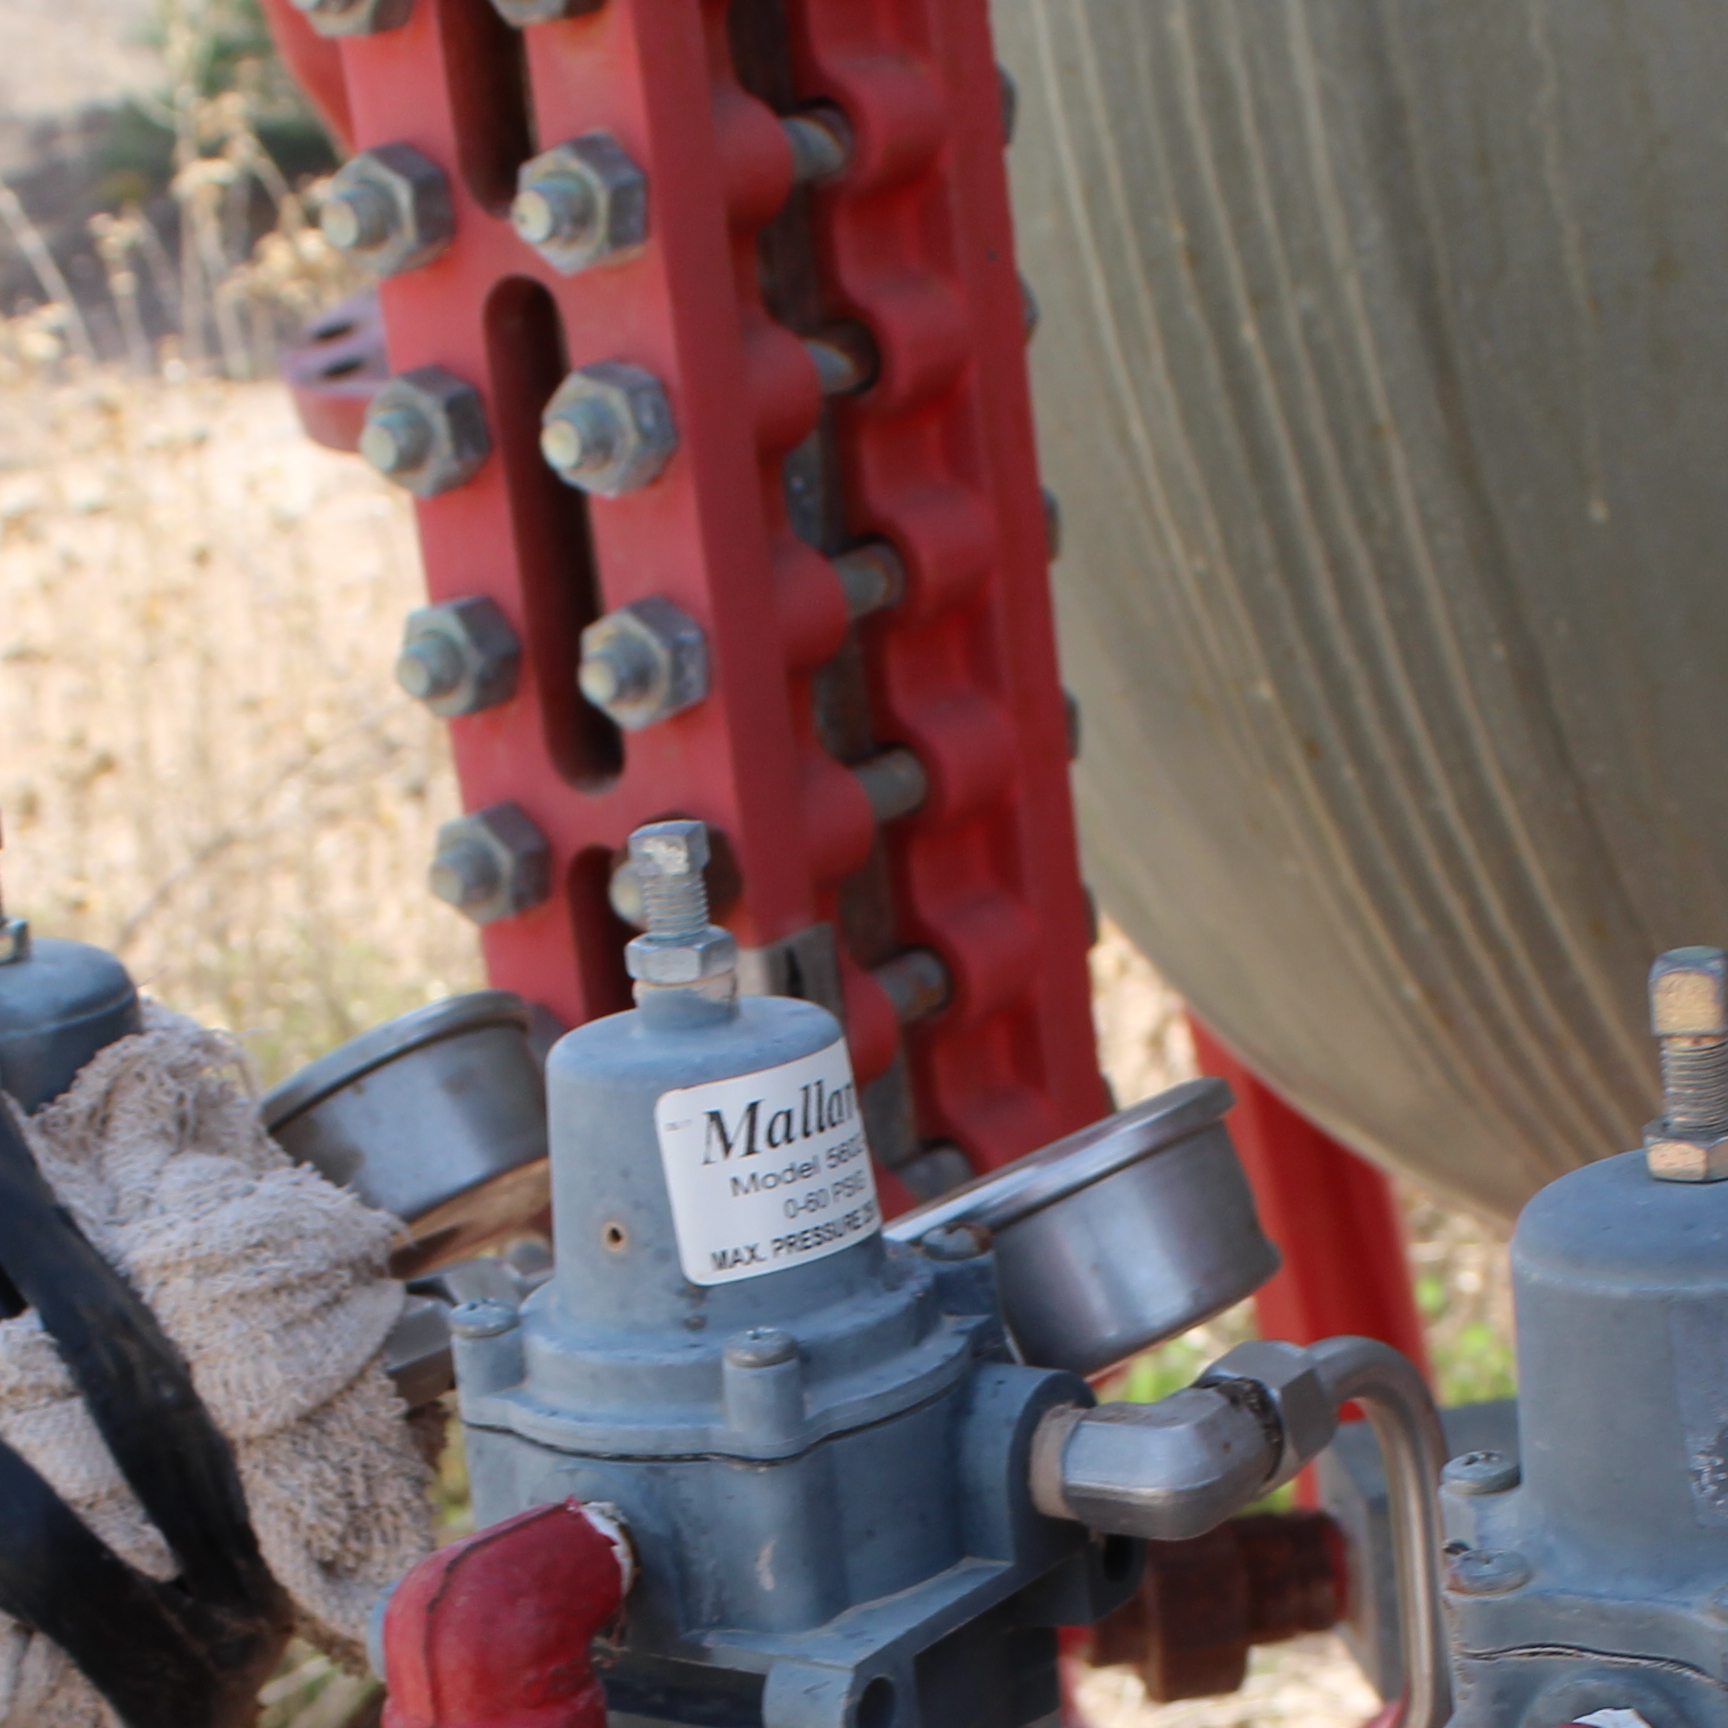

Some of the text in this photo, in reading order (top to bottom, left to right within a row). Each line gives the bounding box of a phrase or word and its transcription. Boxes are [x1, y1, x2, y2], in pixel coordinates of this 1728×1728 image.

[730, 1154, 821, 1198] Model
[783, 1188, 831, 1221] 0-60
[709, 1241, 767, 1272] MAX.
[771, 1207, 862, 1258] PRESSURE
